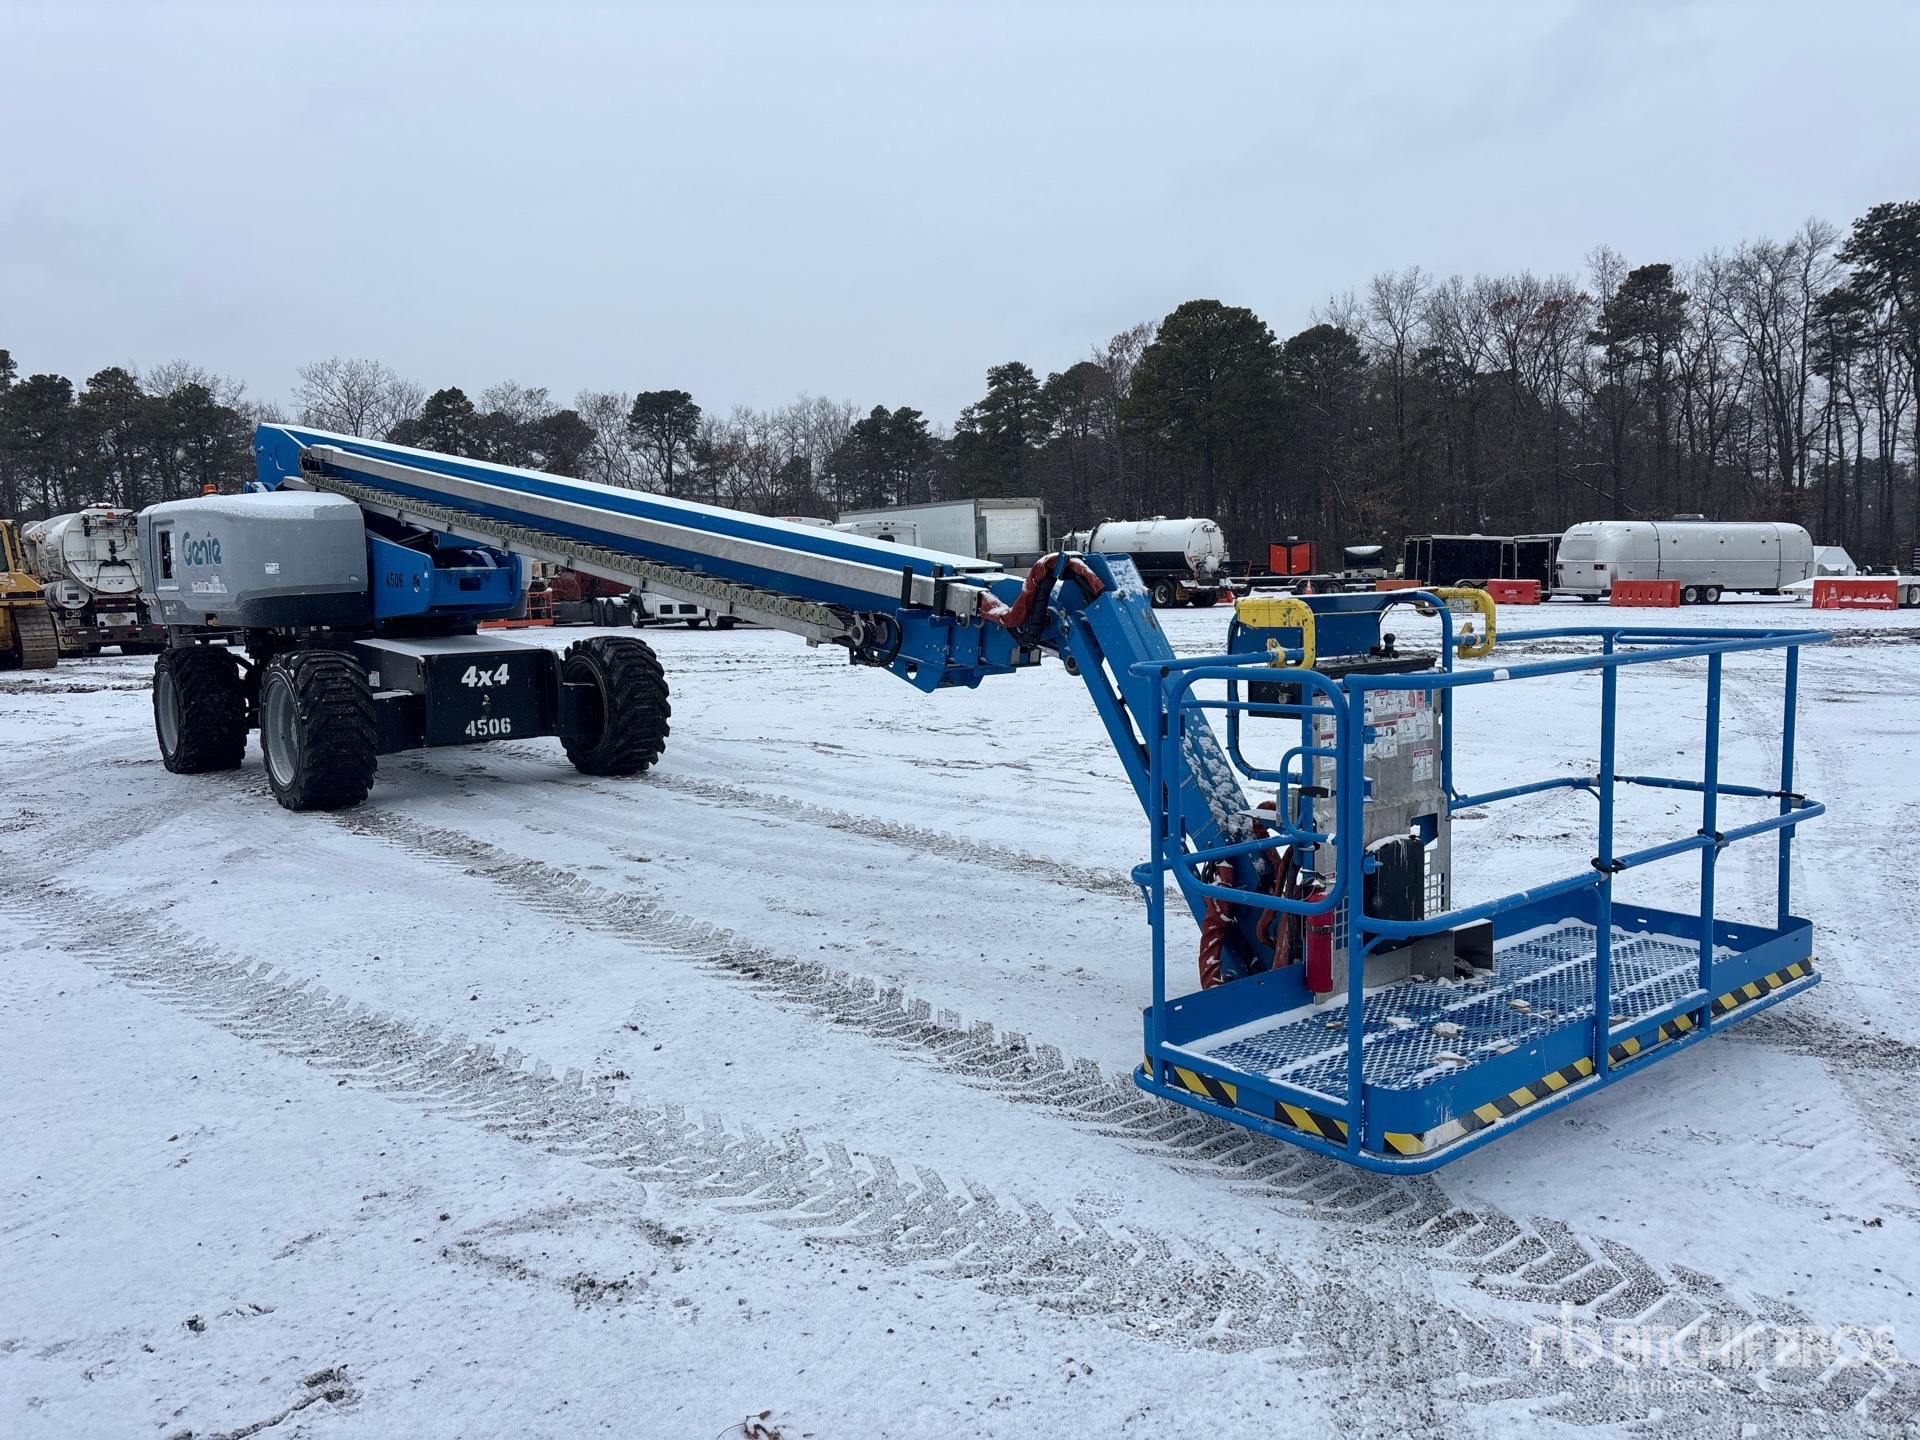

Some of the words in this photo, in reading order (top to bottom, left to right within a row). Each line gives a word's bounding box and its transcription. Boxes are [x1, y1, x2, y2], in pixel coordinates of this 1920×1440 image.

[182, 530, 222, 566] Genie
[385, 572, 404, 588] 4506
[461, 663, 510, 688] 4x4
[465, 717, 512, 737] 4506
